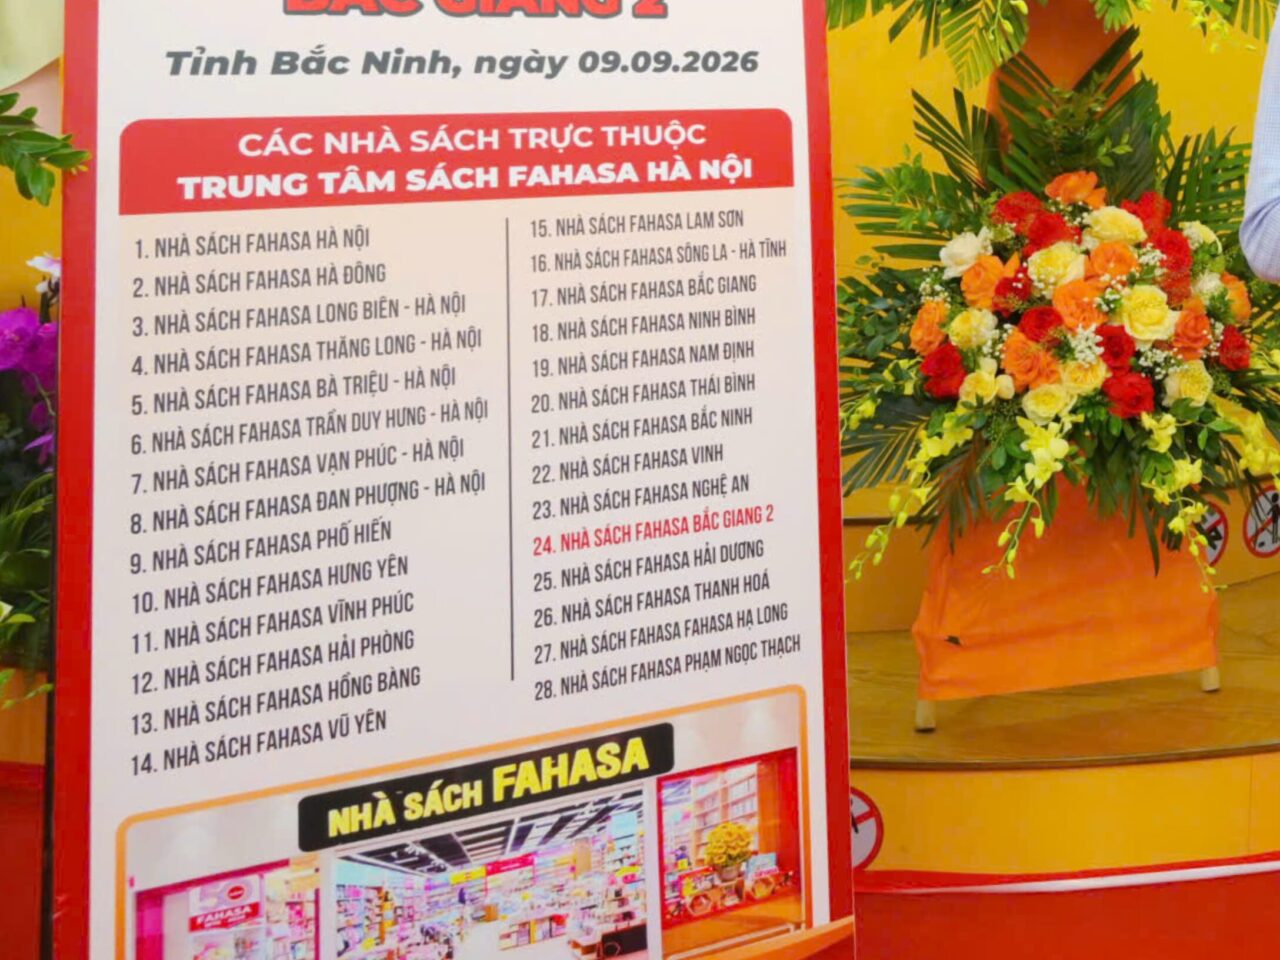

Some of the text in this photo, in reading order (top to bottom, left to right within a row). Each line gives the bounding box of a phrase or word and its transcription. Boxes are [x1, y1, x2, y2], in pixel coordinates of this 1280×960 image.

[166, 42, 760, 82] Tỉnh Bắc Ninh, ngày 09.09.2026
[238, 120, 706, 158] CÁC NHÀ SÁCH TRỰC THUỘC
[177, 153, 752, 200] TRUNG TÂM SÁCH FAHASA HÀ NỘI
[135, 225, 370, 259] 1. NHÀ SÁCH FAHASA HÀ NỘI
[531, 209, 744, 238] 15. NHÀ SÁCH FAHASA LAM SƠN
[533, 504, 774, 557] 24. NHÀ SÁCH FAHASA BẮC GIANG 2
[132, 554, 408, 615] 10. NHÀ SÁCH FAHASA HƯNG YÊN
[534, 634, 801, 701] 28. NHÀ SÁCH FAHASA PHẠM NGỌC THẠCH
[131, 709, 386, 776] 14. NHÀ SÁCH FAHASA VŨ YÊN
[327, 736, 650, 839] NHÀ SÁCH FAHASA
